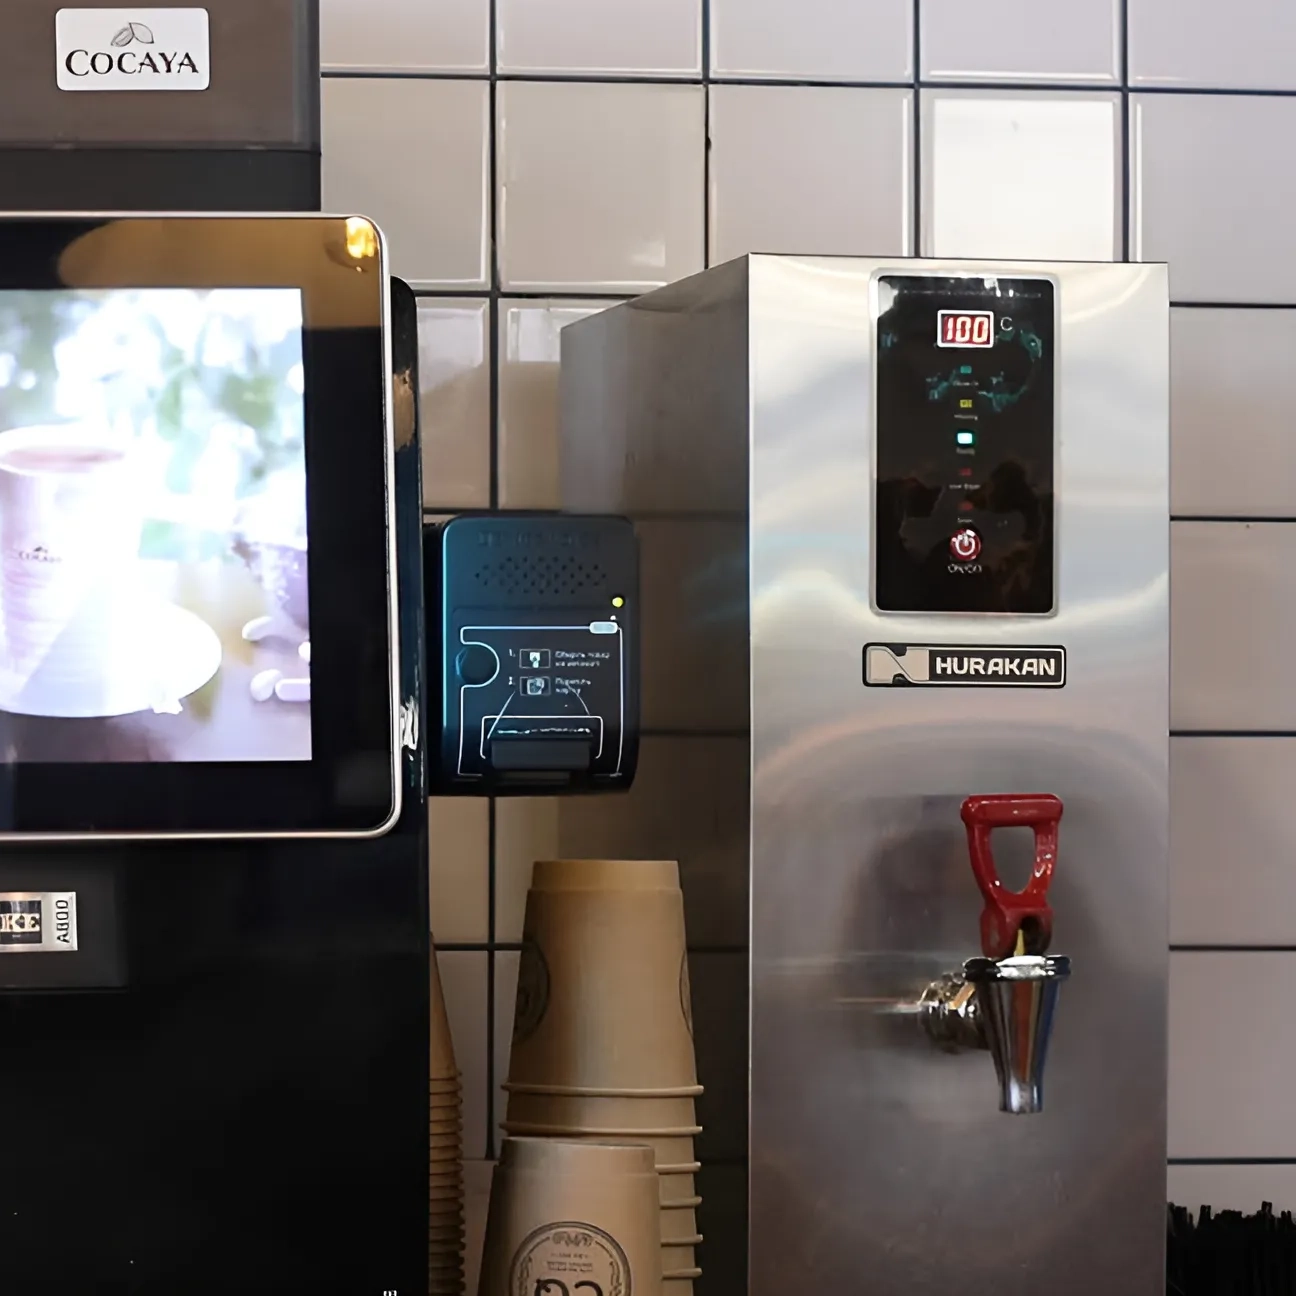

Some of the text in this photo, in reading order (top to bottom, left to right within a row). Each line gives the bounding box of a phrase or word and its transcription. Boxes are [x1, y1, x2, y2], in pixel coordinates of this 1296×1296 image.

[65, 49, 200, 77] COCAYA
[945, 315, 989, 344] 100
[935, 656, 1056, 676] HURAKAN
